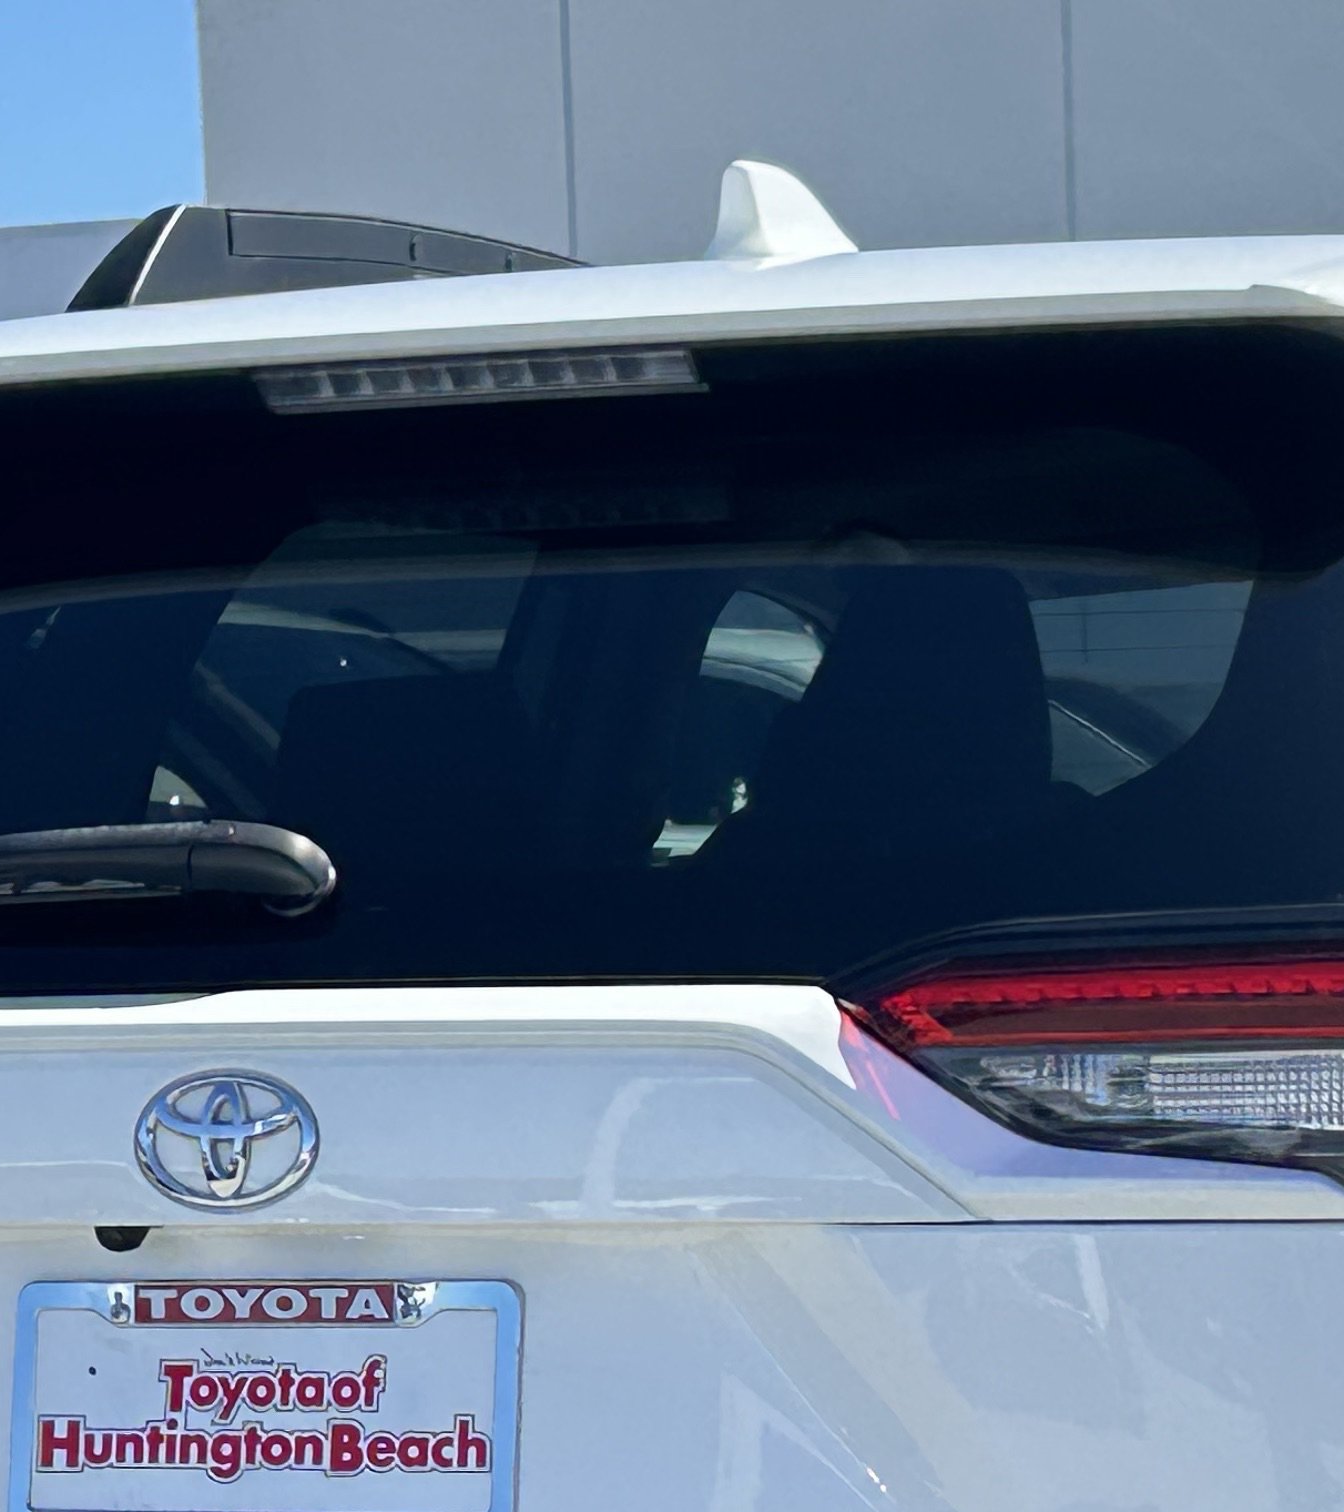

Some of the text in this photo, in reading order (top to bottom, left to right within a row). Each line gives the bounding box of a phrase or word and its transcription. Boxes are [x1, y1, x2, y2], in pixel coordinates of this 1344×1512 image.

[138, 1287, 389, 1320] TOYOTA
[162, 1357, 383, 1422] Toyota of
[39, 1418, 488, 1479] Huntington Beach
